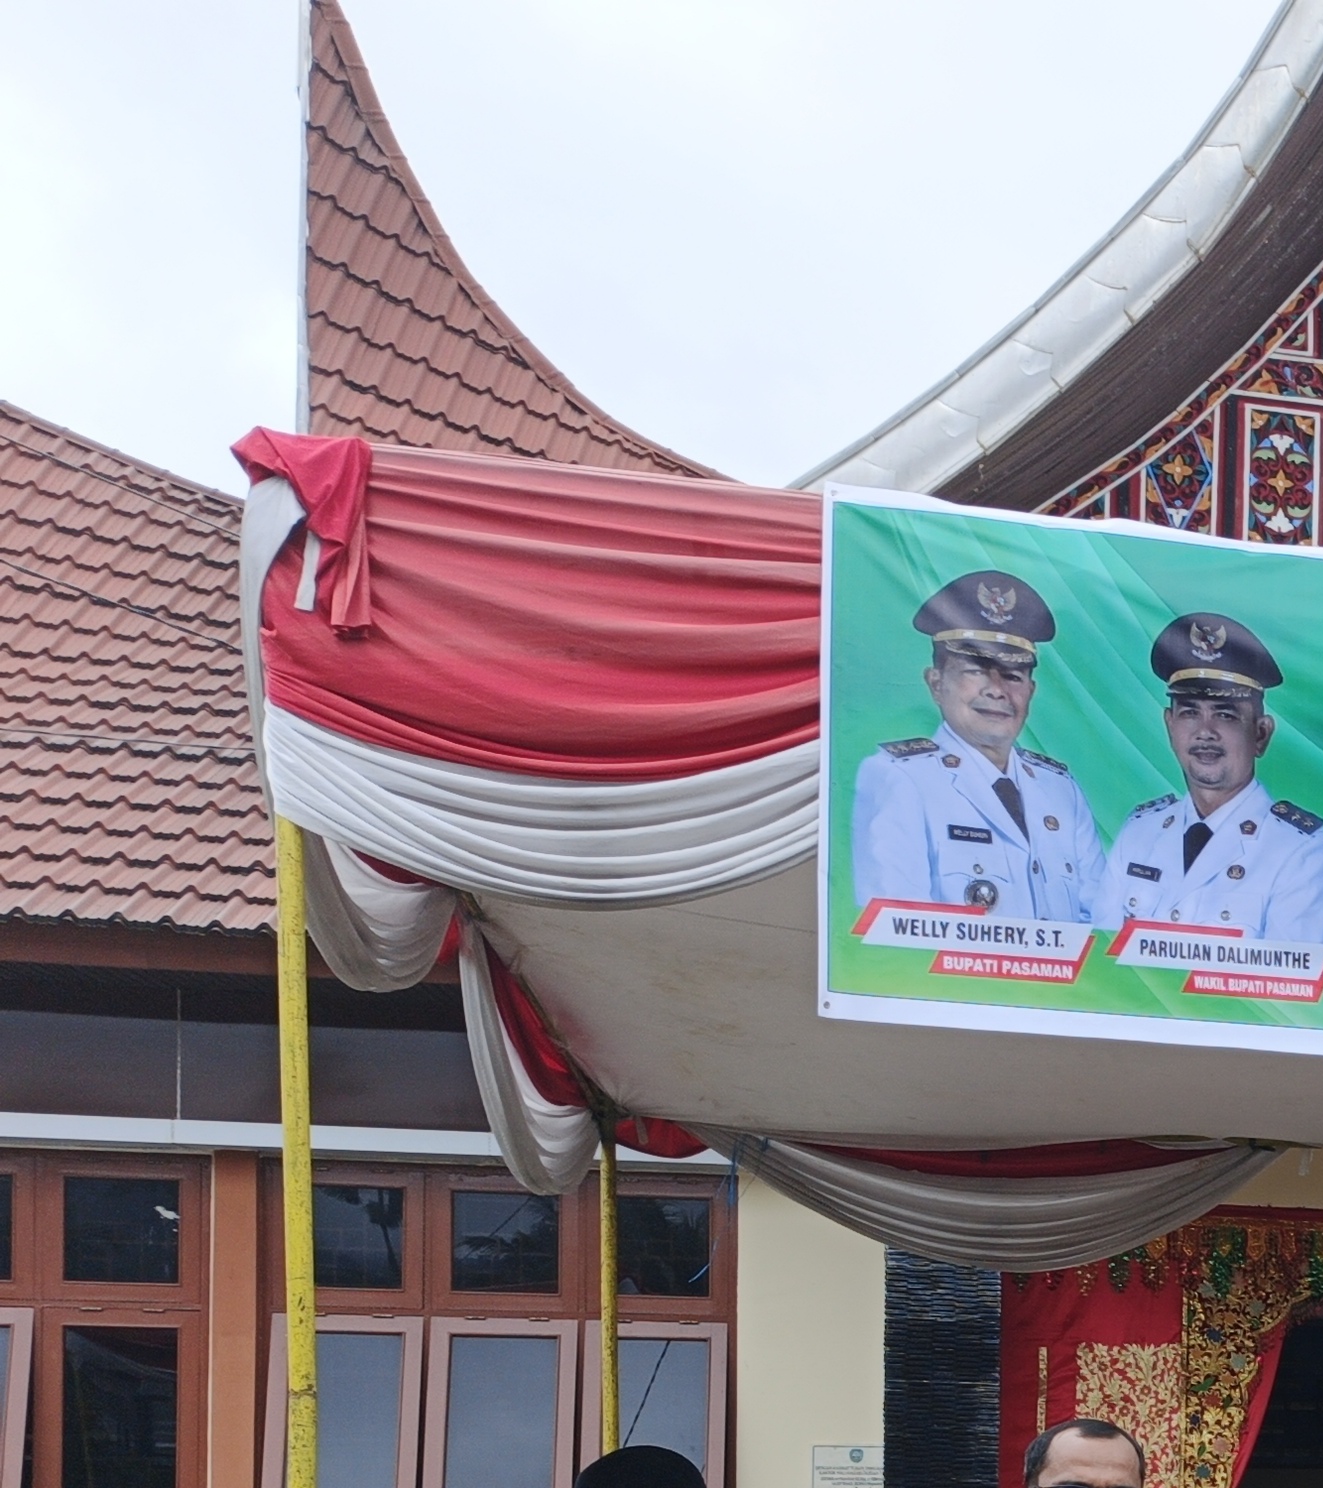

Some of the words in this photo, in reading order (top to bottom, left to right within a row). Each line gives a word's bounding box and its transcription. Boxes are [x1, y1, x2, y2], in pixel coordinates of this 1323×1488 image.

[892, 916, 949, 939] WELLY
[956, 922, 1029, 948] SUHERY,
[1035, 928, 1065, 949] S.T.
[943, 956, 998, 974] BUPATI
[1001, 960, 1073, 980] PASAMAN
[1140, 938, 1211, 962] PARULIAN
[1217, 945, 1310, 970] DALIMUNTHE
[1194, 975, 1226, 990] WAKIL
[1228, 978, 1264, 994] BUPATI
[1266, 981, 1313, 997] PASAMAN
